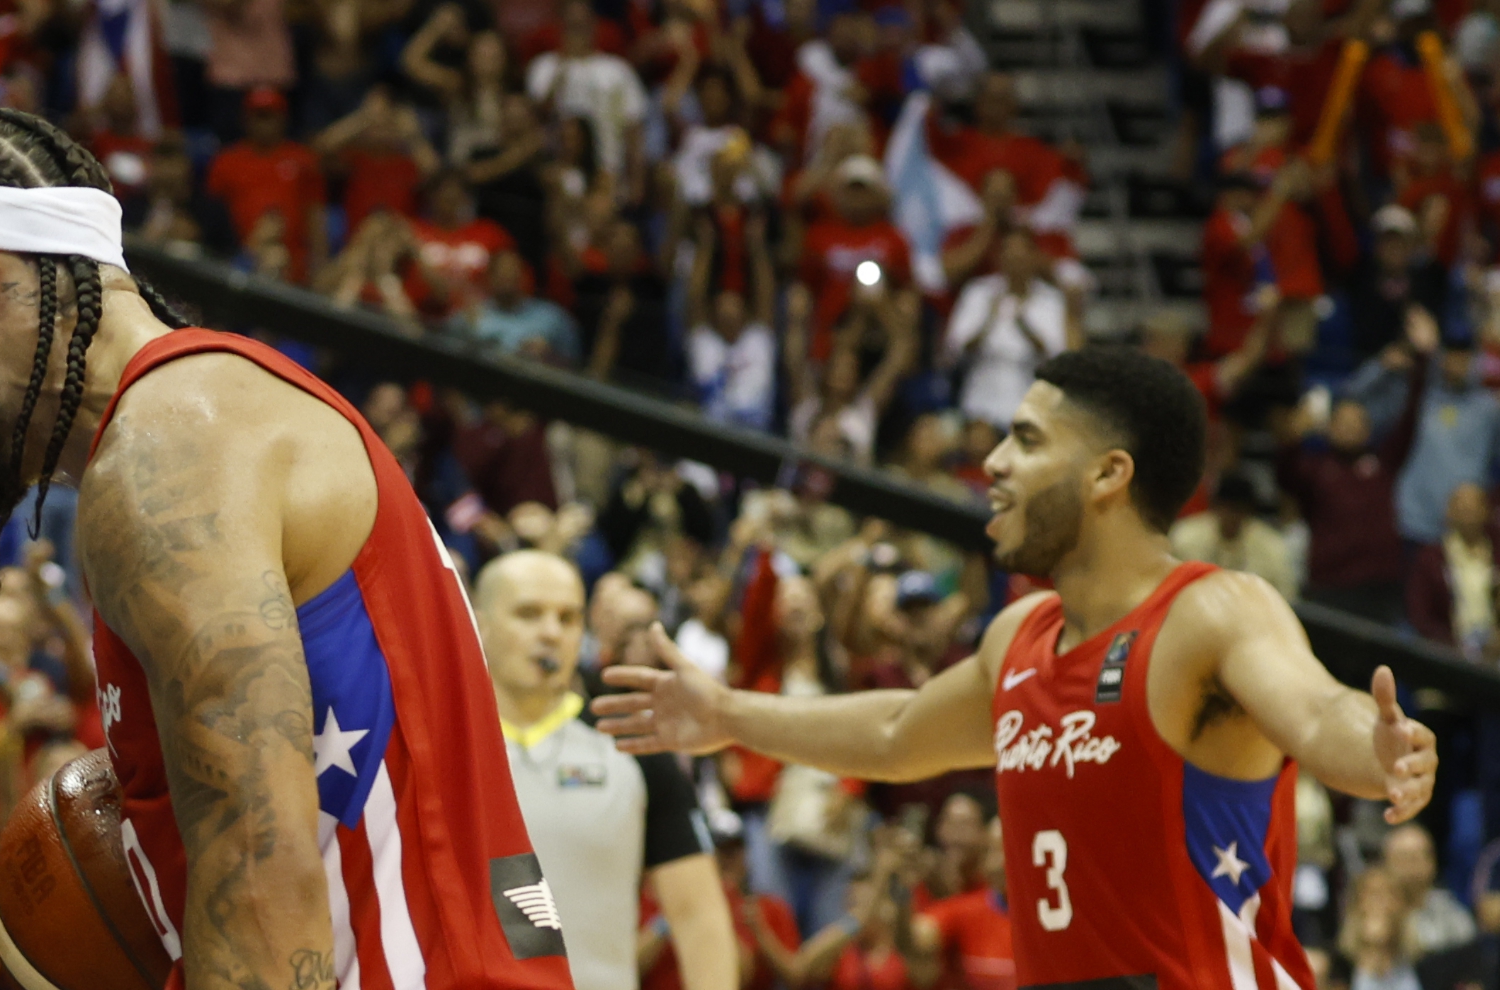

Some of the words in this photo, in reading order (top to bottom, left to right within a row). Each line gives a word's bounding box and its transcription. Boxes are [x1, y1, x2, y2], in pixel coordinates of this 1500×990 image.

[996, 710, 1052, 773] Puerto
[1050, 710, 1121, 779] Rico
[1032, 829, 1073, 931] 3
